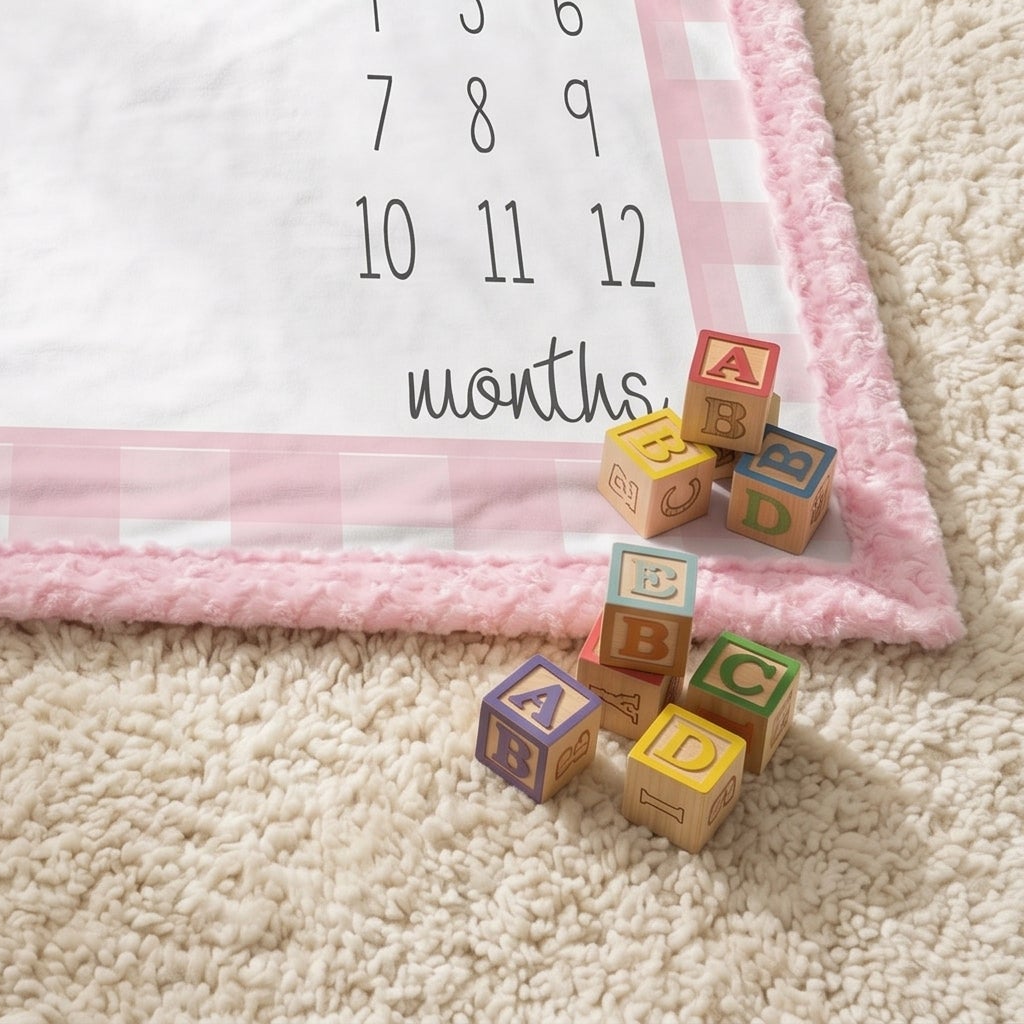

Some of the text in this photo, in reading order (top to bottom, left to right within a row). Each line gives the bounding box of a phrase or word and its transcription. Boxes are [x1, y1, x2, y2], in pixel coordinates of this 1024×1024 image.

[367, 75, 599, 157] 7 8 9
[356, 196, 655, 287] 10 11 12
[407, 336, 668, 423] months
[706, 346, 760, 386] A
[701, 396, 747, 440] B
[630, 428, 688, 463] B
[757, 443, 813, 482] B
[742, 487, 791, 535] D
[618, 616, 669, 661] B
[720, 653, 777, 696] C
[508, 684, 564, 730] A
[492, 721, 531, 779] B
[653, 726, 717, 772] D
